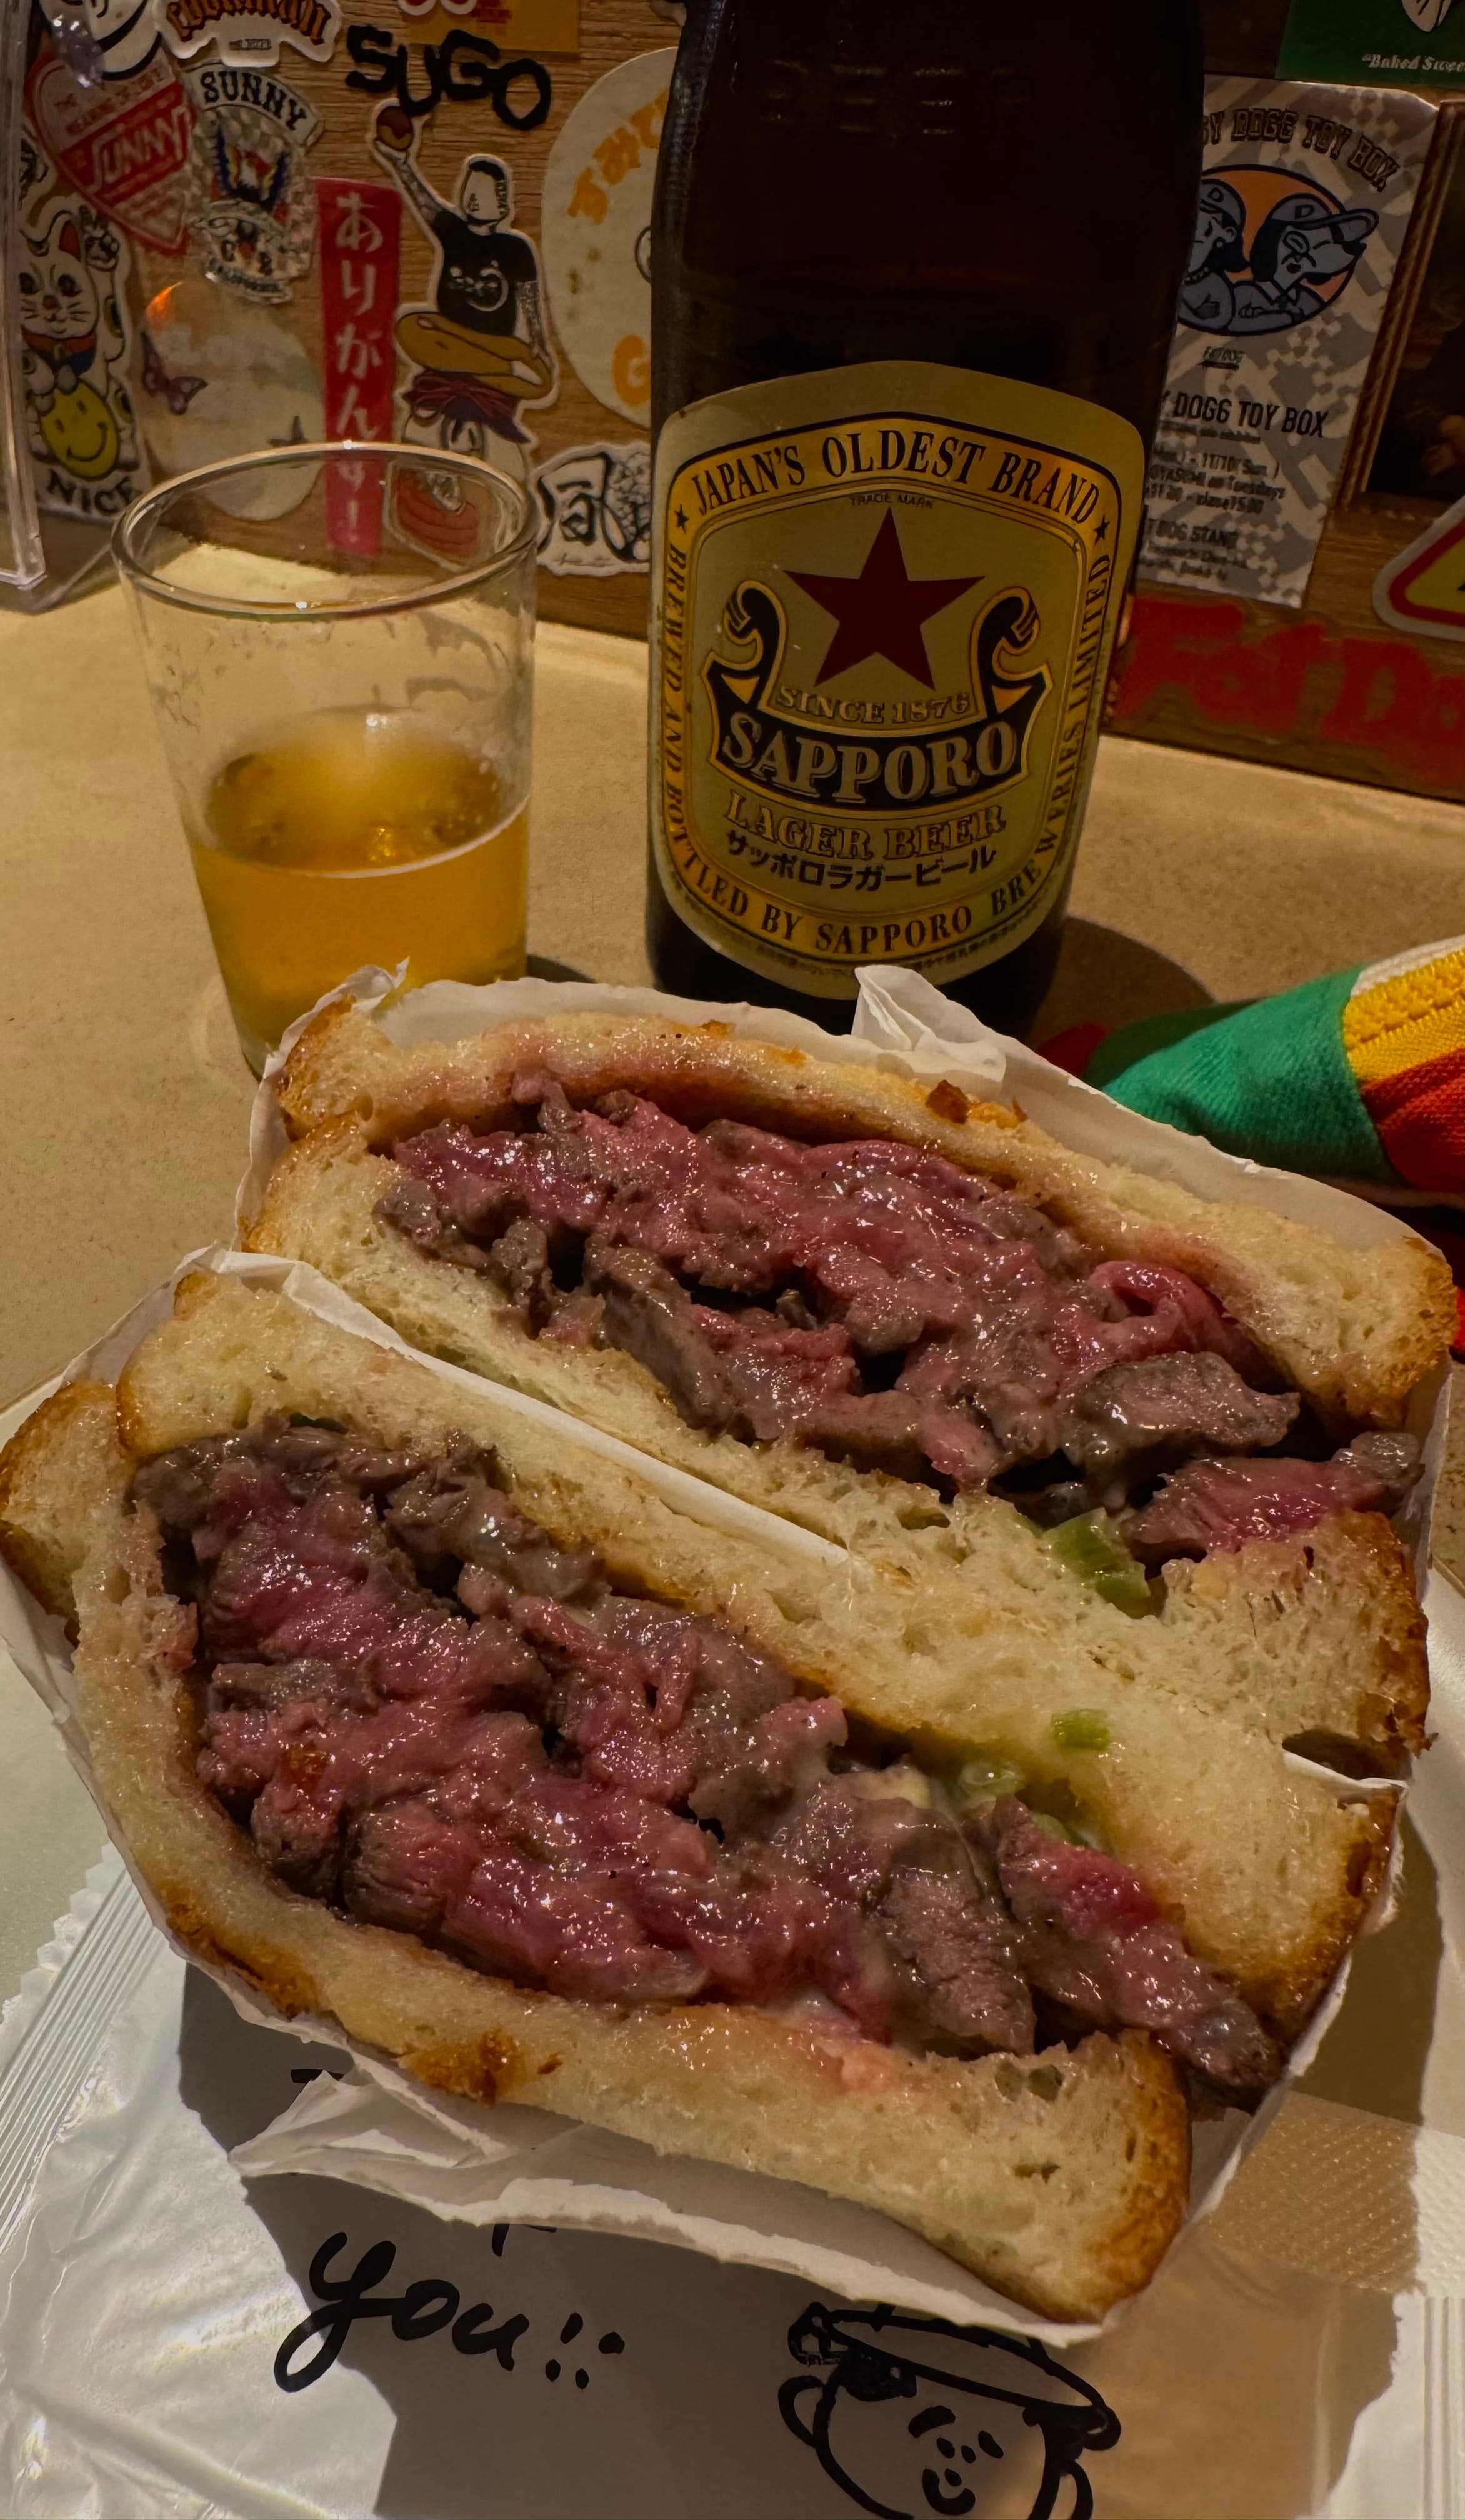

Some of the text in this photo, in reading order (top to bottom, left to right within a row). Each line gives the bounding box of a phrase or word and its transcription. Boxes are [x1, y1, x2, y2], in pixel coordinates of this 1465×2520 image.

[200, 71, 308, 131] SUNNY
[345, 25, 551, 131] SUGO
[1302, 114, 1353, 161] TOY
[1348, 130, 1401, 192] BOX
[1238, 400, 1281, 431] TOY
[1281, 406, 1329, 438] BOX
[691, 444, 806, 517] JAPAN'S
[822, 429, 986, 484] OLDEST
[988, 451, 1101, 526] BRAND
[850, 492, 933, 509] TRADE MARK
[776, 686, 972, 724] SINCE 1876
[664, 542, 1110, 953] BREWED AND BOTTLED BY SAPPORO BREWERIES LIMITED
[721, 711, 1020, 804] SAPPORO
[723, 789, 1008, 861] LAGER BEER
[726, 829, 998, 892] サッポロラガービール
